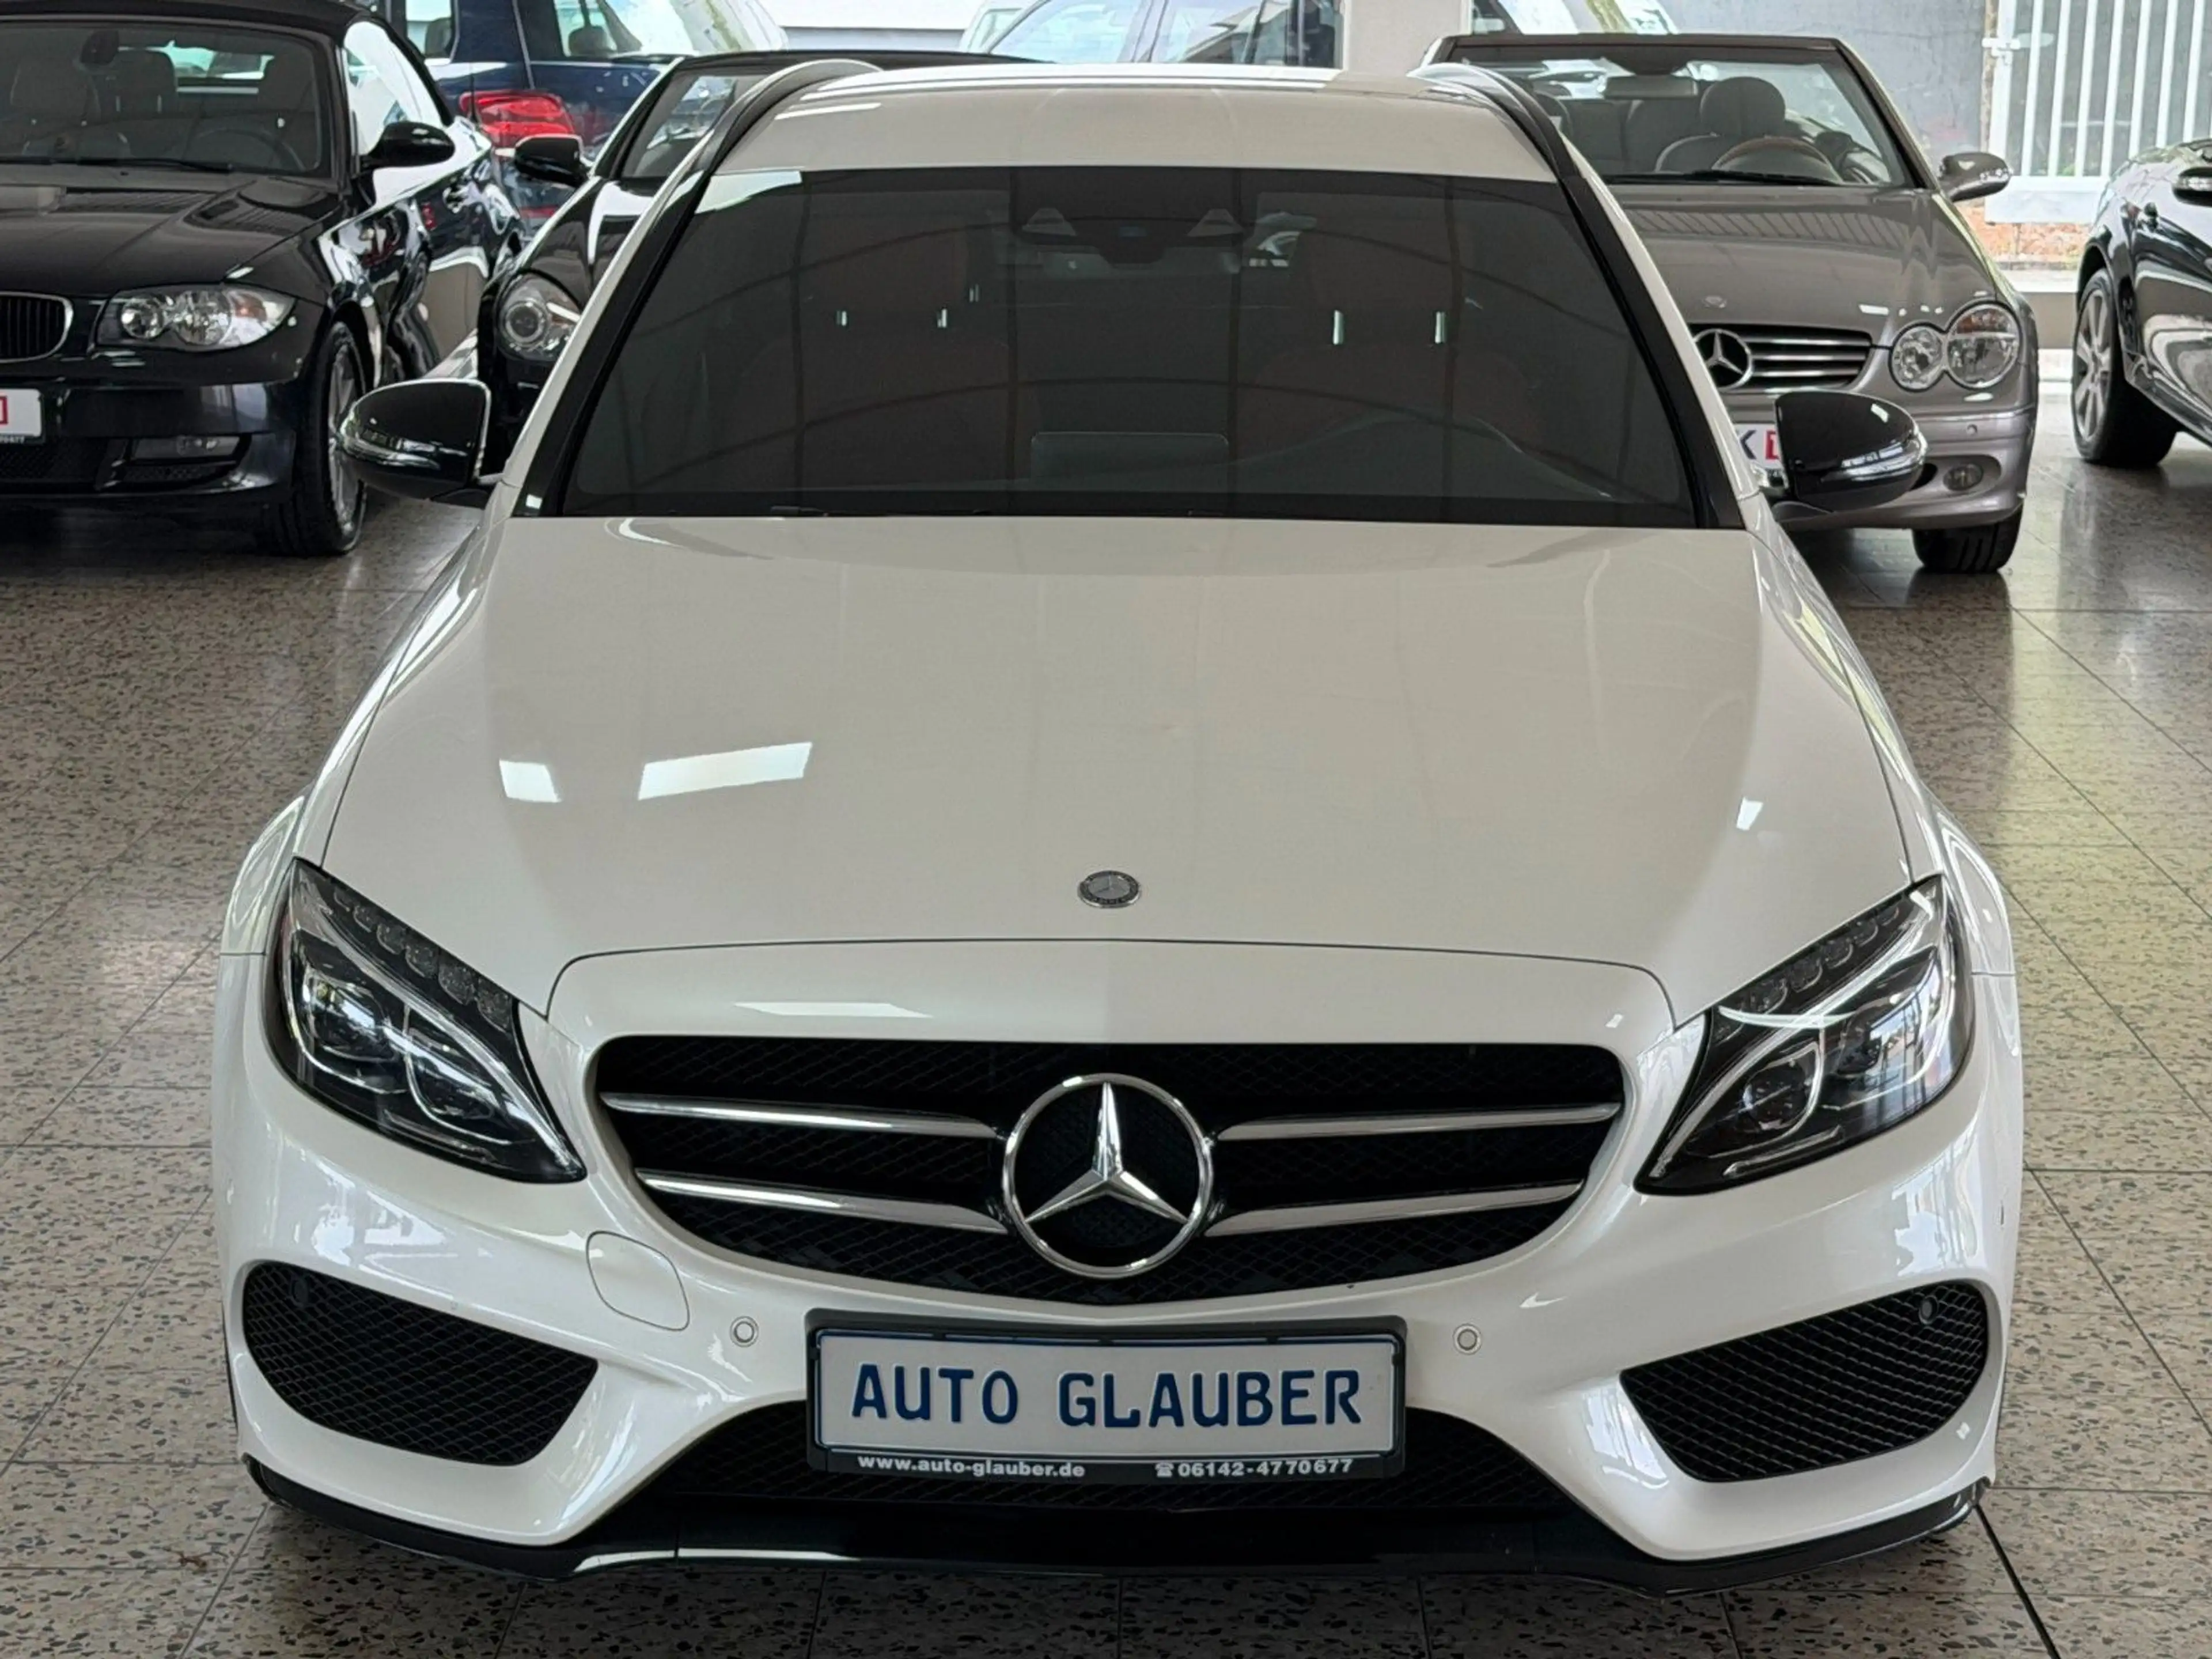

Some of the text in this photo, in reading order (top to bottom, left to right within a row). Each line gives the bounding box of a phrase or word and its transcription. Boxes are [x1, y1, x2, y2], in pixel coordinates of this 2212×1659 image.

[851, 1363, 1362, 1428] AUTO GLAUBER
[857, 1455, 1086, 1478] www.auto-glauber.de
[1177, 1458, 1354, 1478] 06142-4770677
